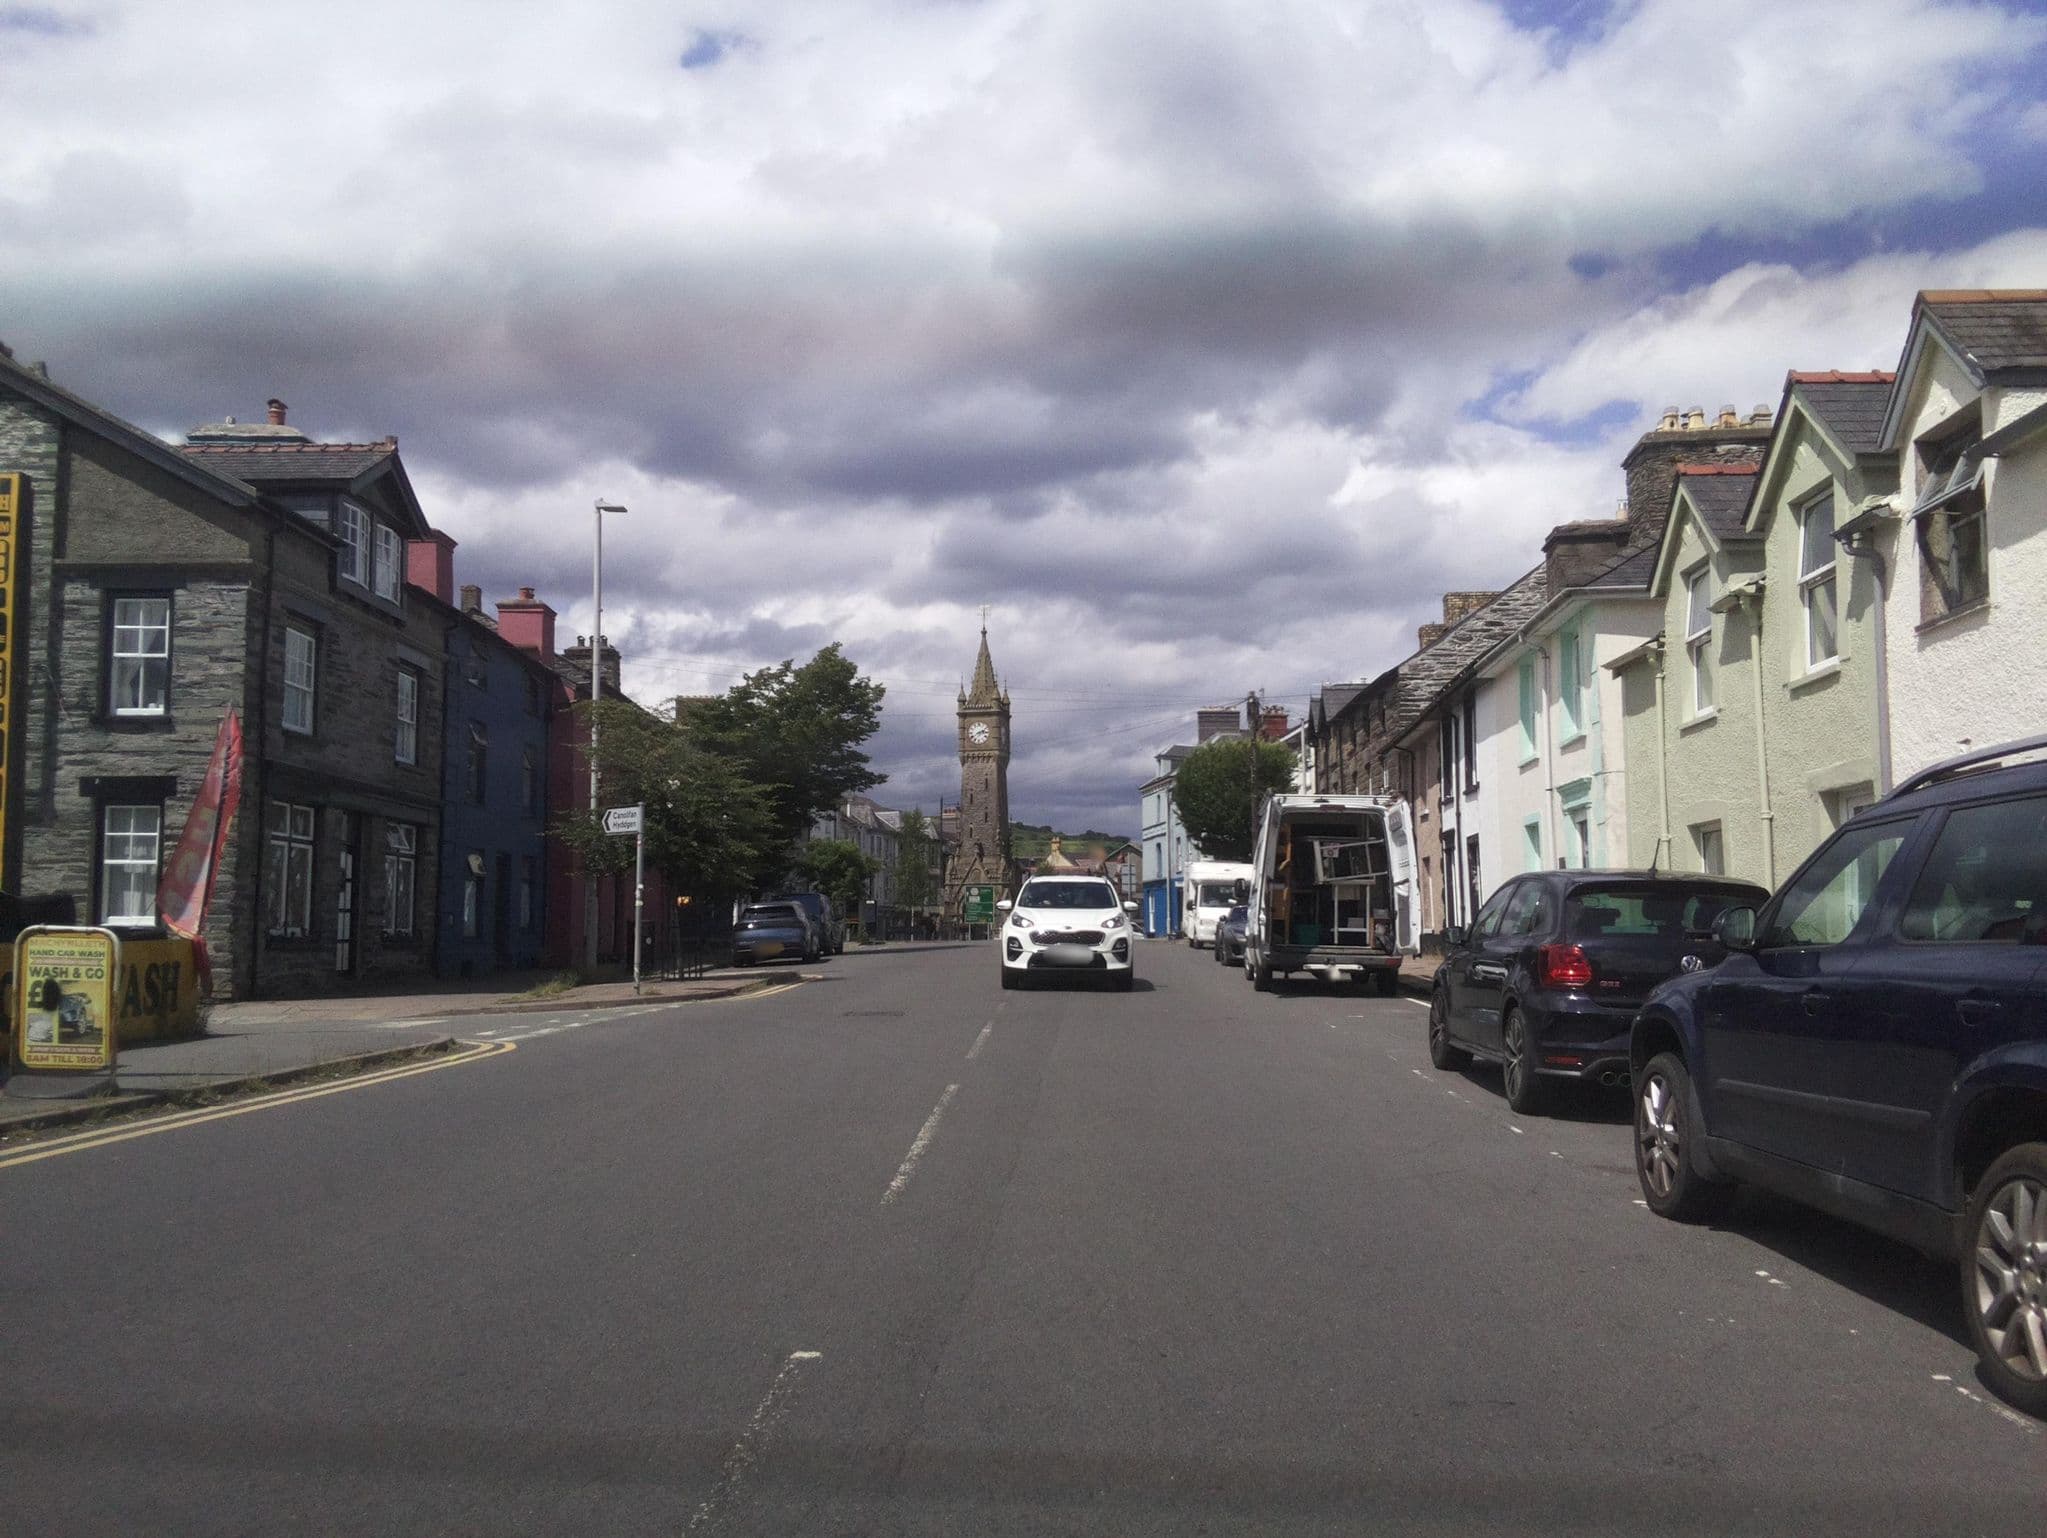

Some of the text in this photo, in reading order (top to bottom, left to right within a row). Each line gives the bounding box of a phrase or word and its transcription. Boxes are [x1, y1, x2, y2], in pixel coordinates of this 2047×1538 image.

[613, 811, 637, 819] Canolfan
[613, 821, 637, 829] Hyddgen
[29, 949, 55, 957] HAND
[78, 950, 105, 958] WASH
[29, 966, 105, 980] WASH & GO
[119, 959, 182, 1018] ASH
[52, 1055, 74, 1063] TILL
